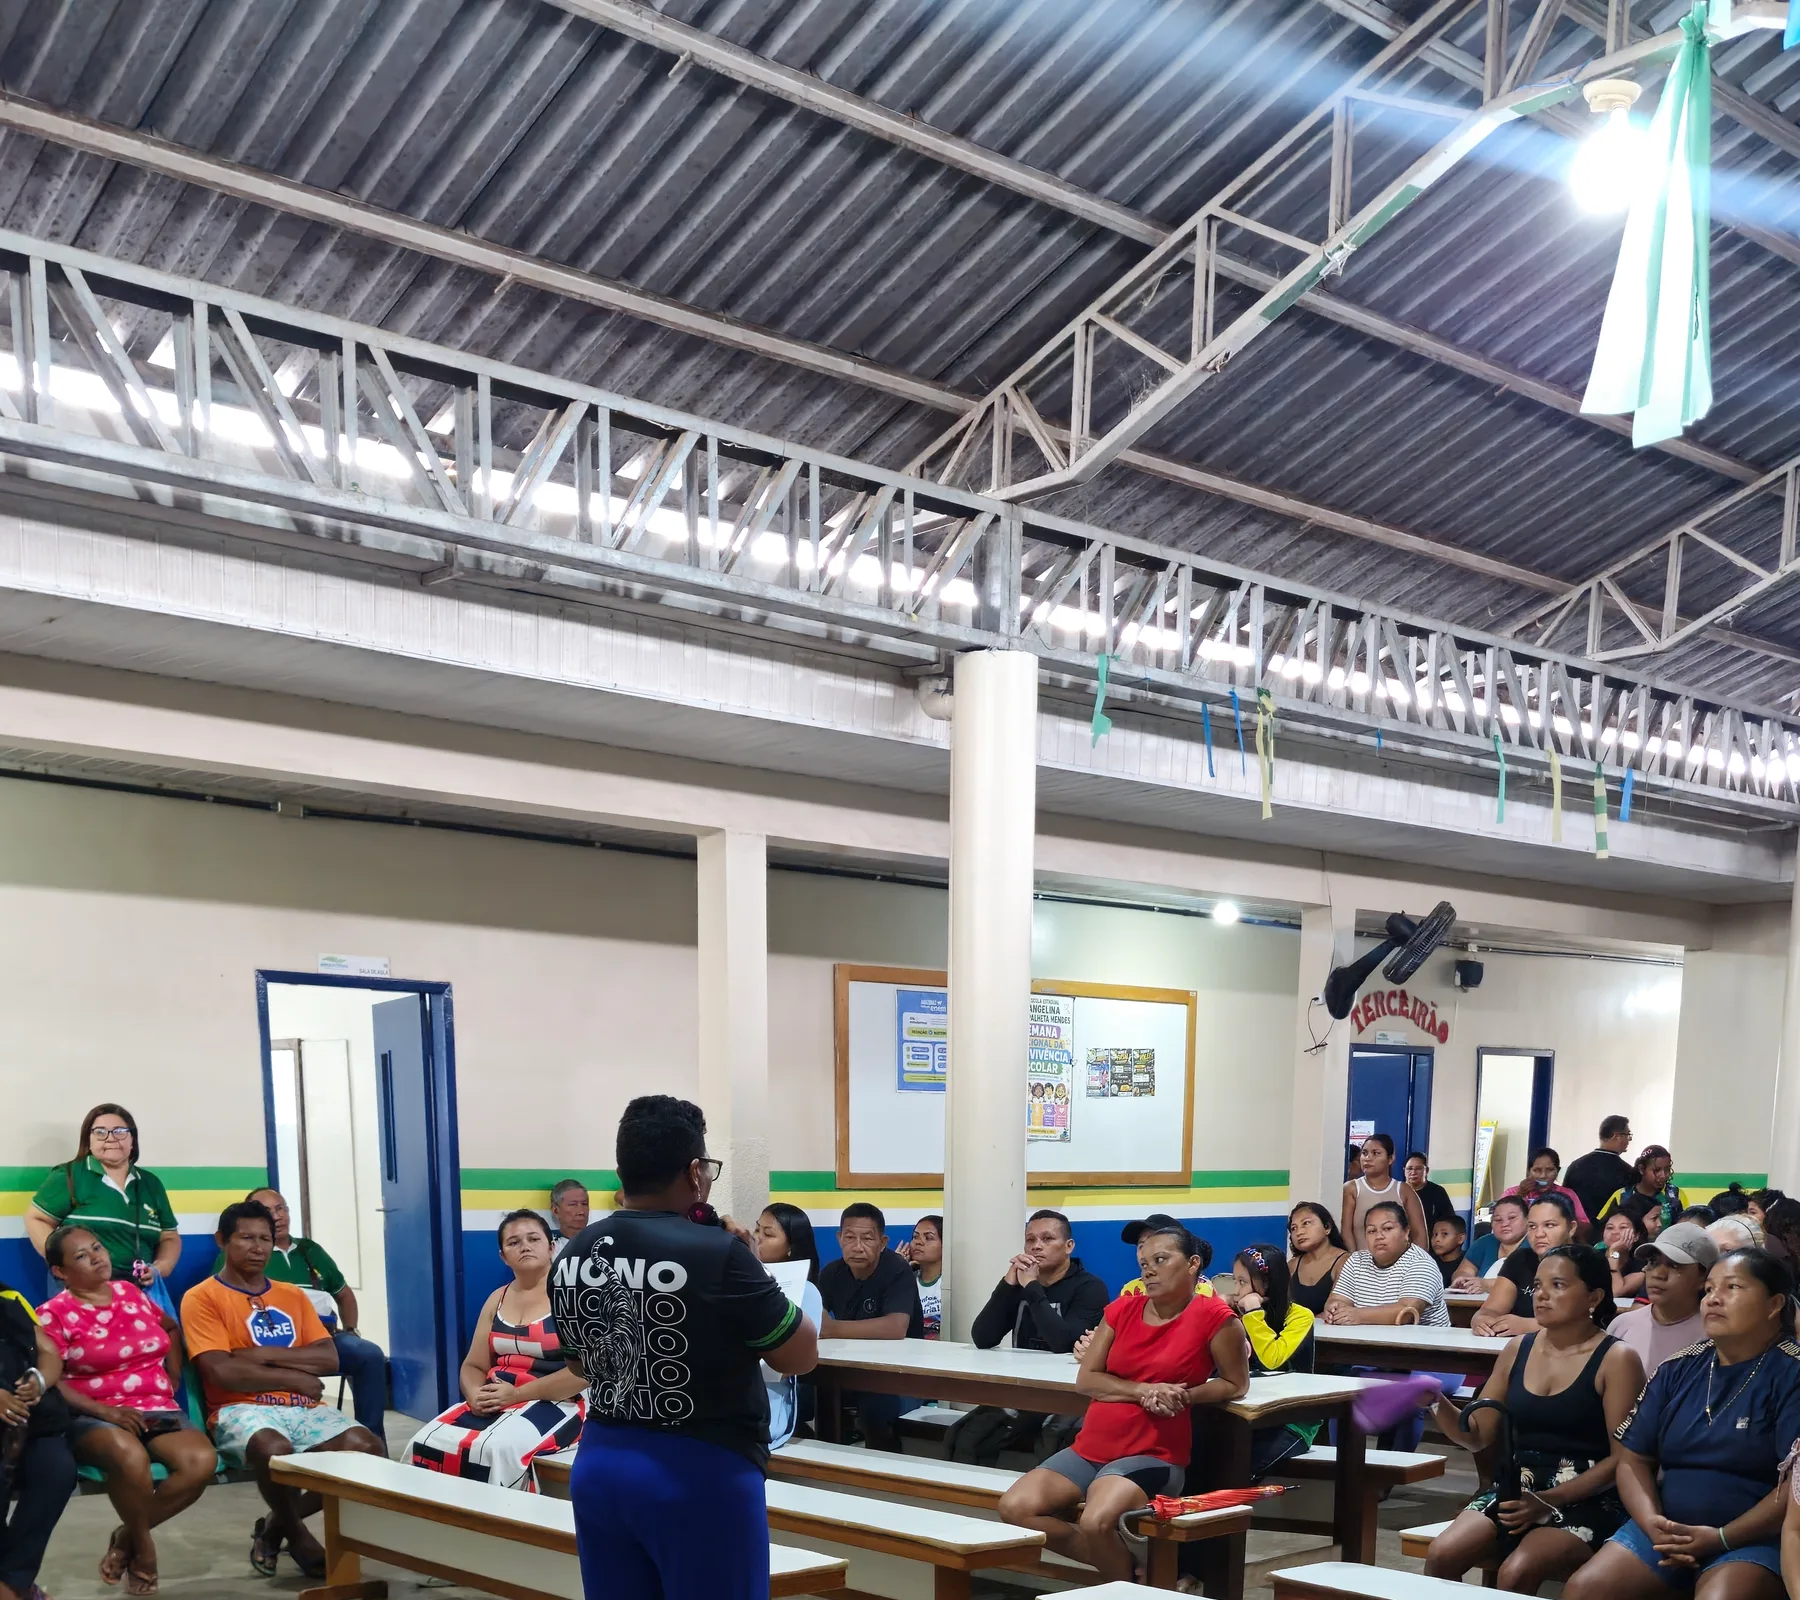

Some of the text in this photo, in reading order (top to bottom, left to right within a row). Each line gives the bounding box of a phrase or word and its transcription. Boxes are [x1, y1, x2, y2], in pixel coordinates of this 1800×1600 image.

[1030, 1014, 1071, 1025] ALHETA MENDES
[1351, 989, 1449, 1044] TERCEIRÃO
[1029, 1038, 1063, 1049] IONAL DA
[1029, 1061, 1058, 1074] COLAR
[553, 1256, 688, 1293] NONO
[254, 1322, 293, 1338] PARE
[1613, 1415, 1633, 1440] LOUIS
